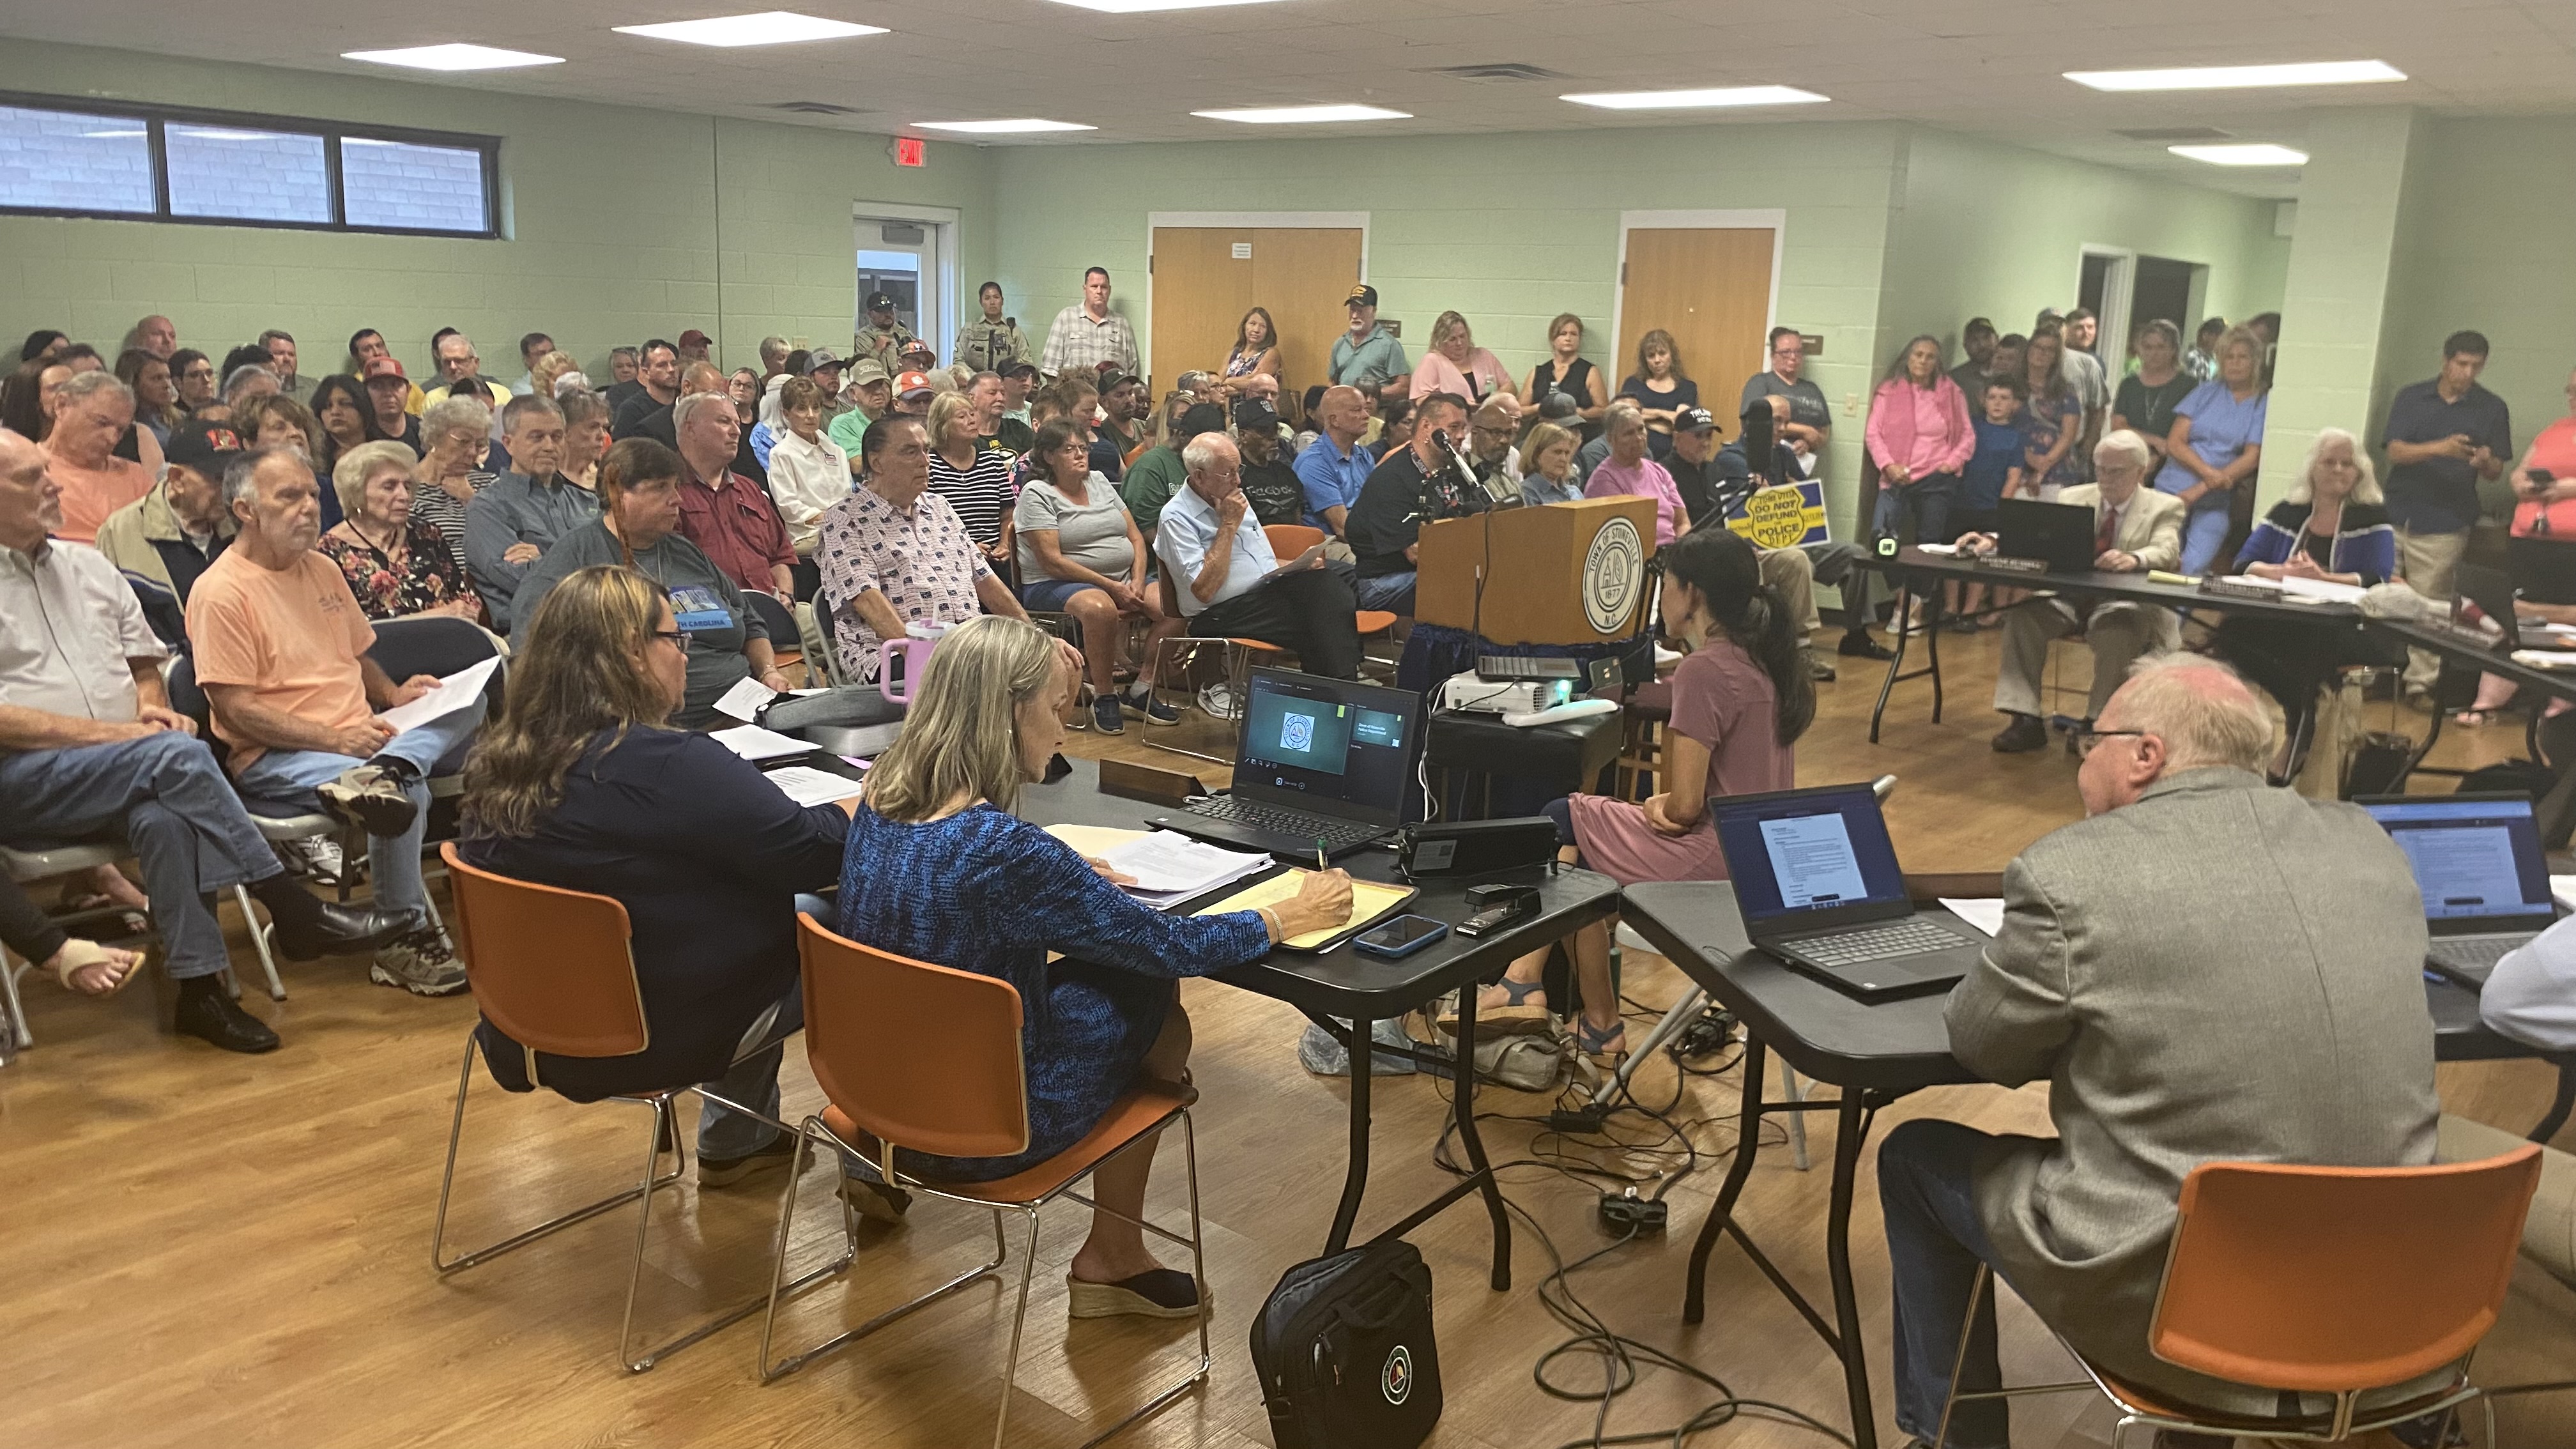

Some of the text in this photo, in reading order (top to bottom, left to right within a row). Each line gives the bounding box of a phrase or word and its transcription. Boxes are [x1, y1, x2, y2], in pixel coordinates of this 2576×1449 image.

[1755, 500, 1796, 514] DO NOT
[1756, 510, 1797, 523] DEFUND
[1758, 523, 1798, 537] POLICE
[1589, 528, 1638, 573] TOWN OF STONEVILLE
[1605, 588, 1620, 599] 1877
